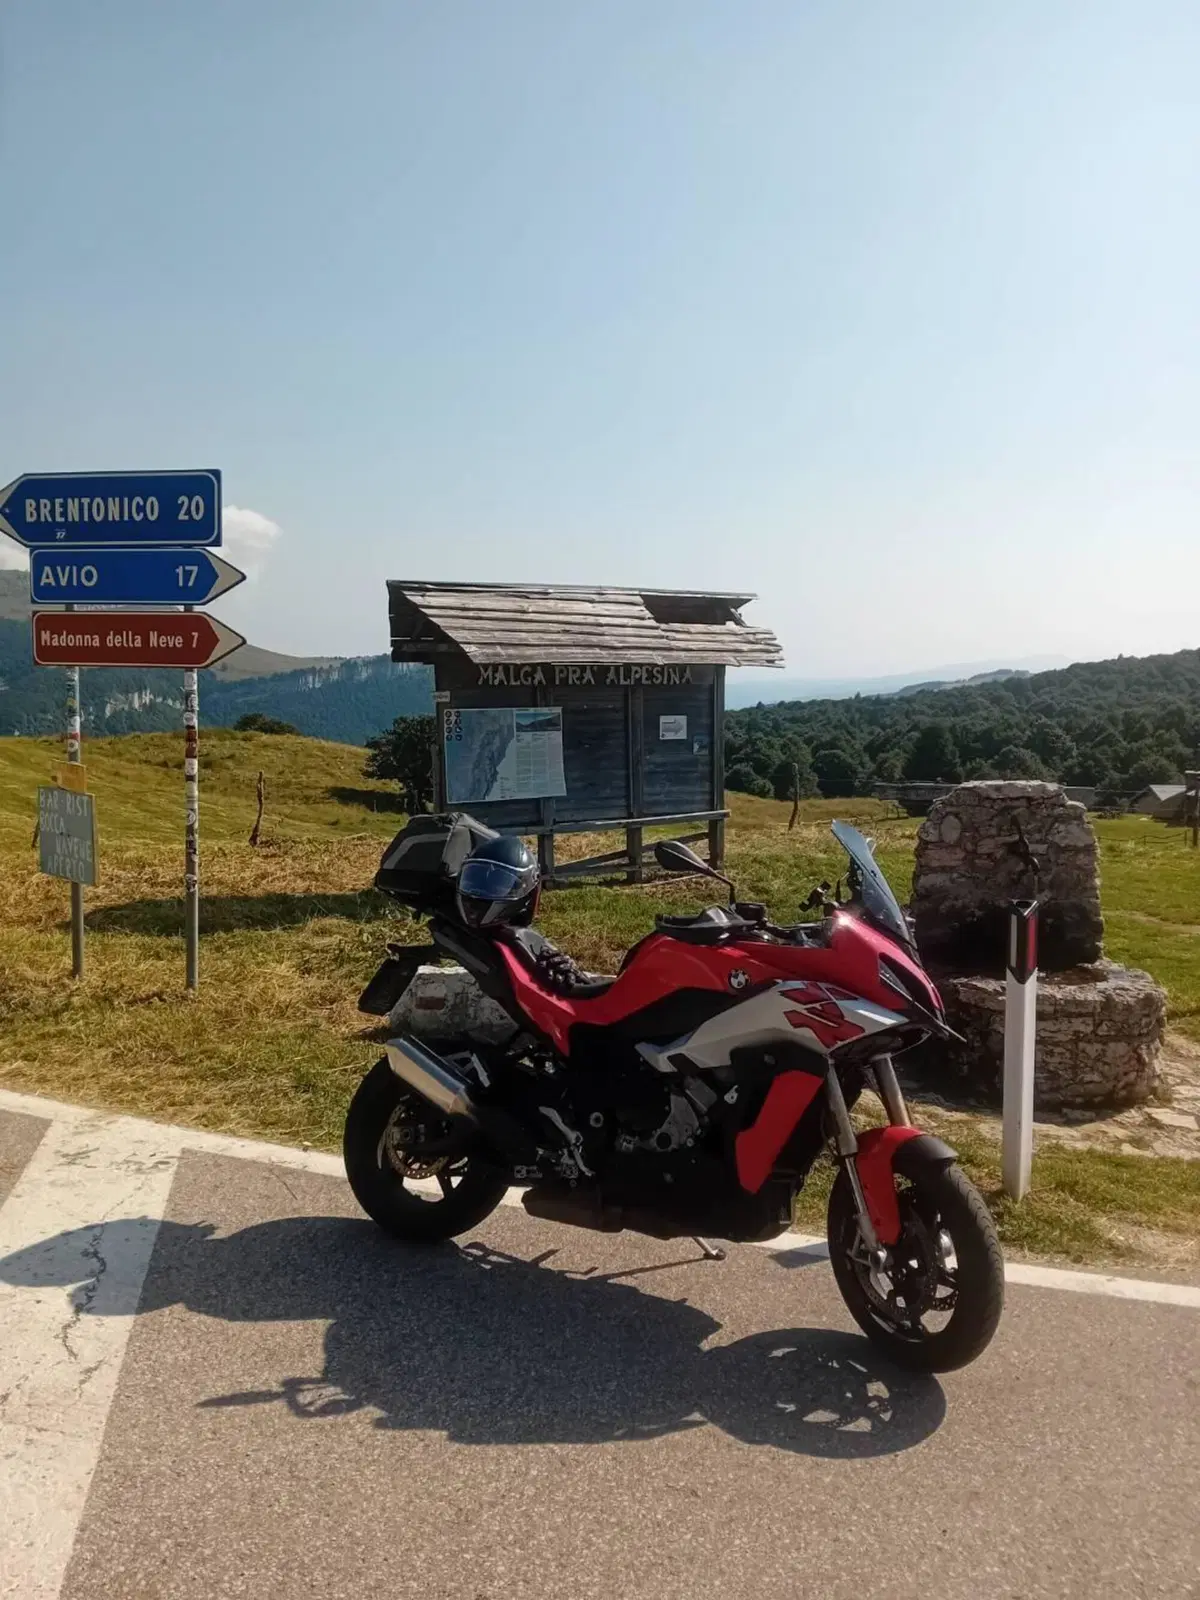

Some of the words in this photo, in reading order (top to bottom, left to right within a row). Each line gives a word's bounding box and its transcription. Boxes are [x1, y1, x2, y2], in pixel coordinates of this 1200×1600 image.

[25, 496, 159, 523] BRENTONICO
[177, 495, 205, 521] 20
[40, 565, 99, 587] AVIO
[175, 565, 199, 587] 17
[41, 630, 100, 647] Madonna
[106, 630, 142, 648] della
[149, 630, 184, 648] Neve
[191, 632, 199, 648] 7
[478, 664, 547, 686] MALGA
[606, 664, 694, 686] ALPESINA
